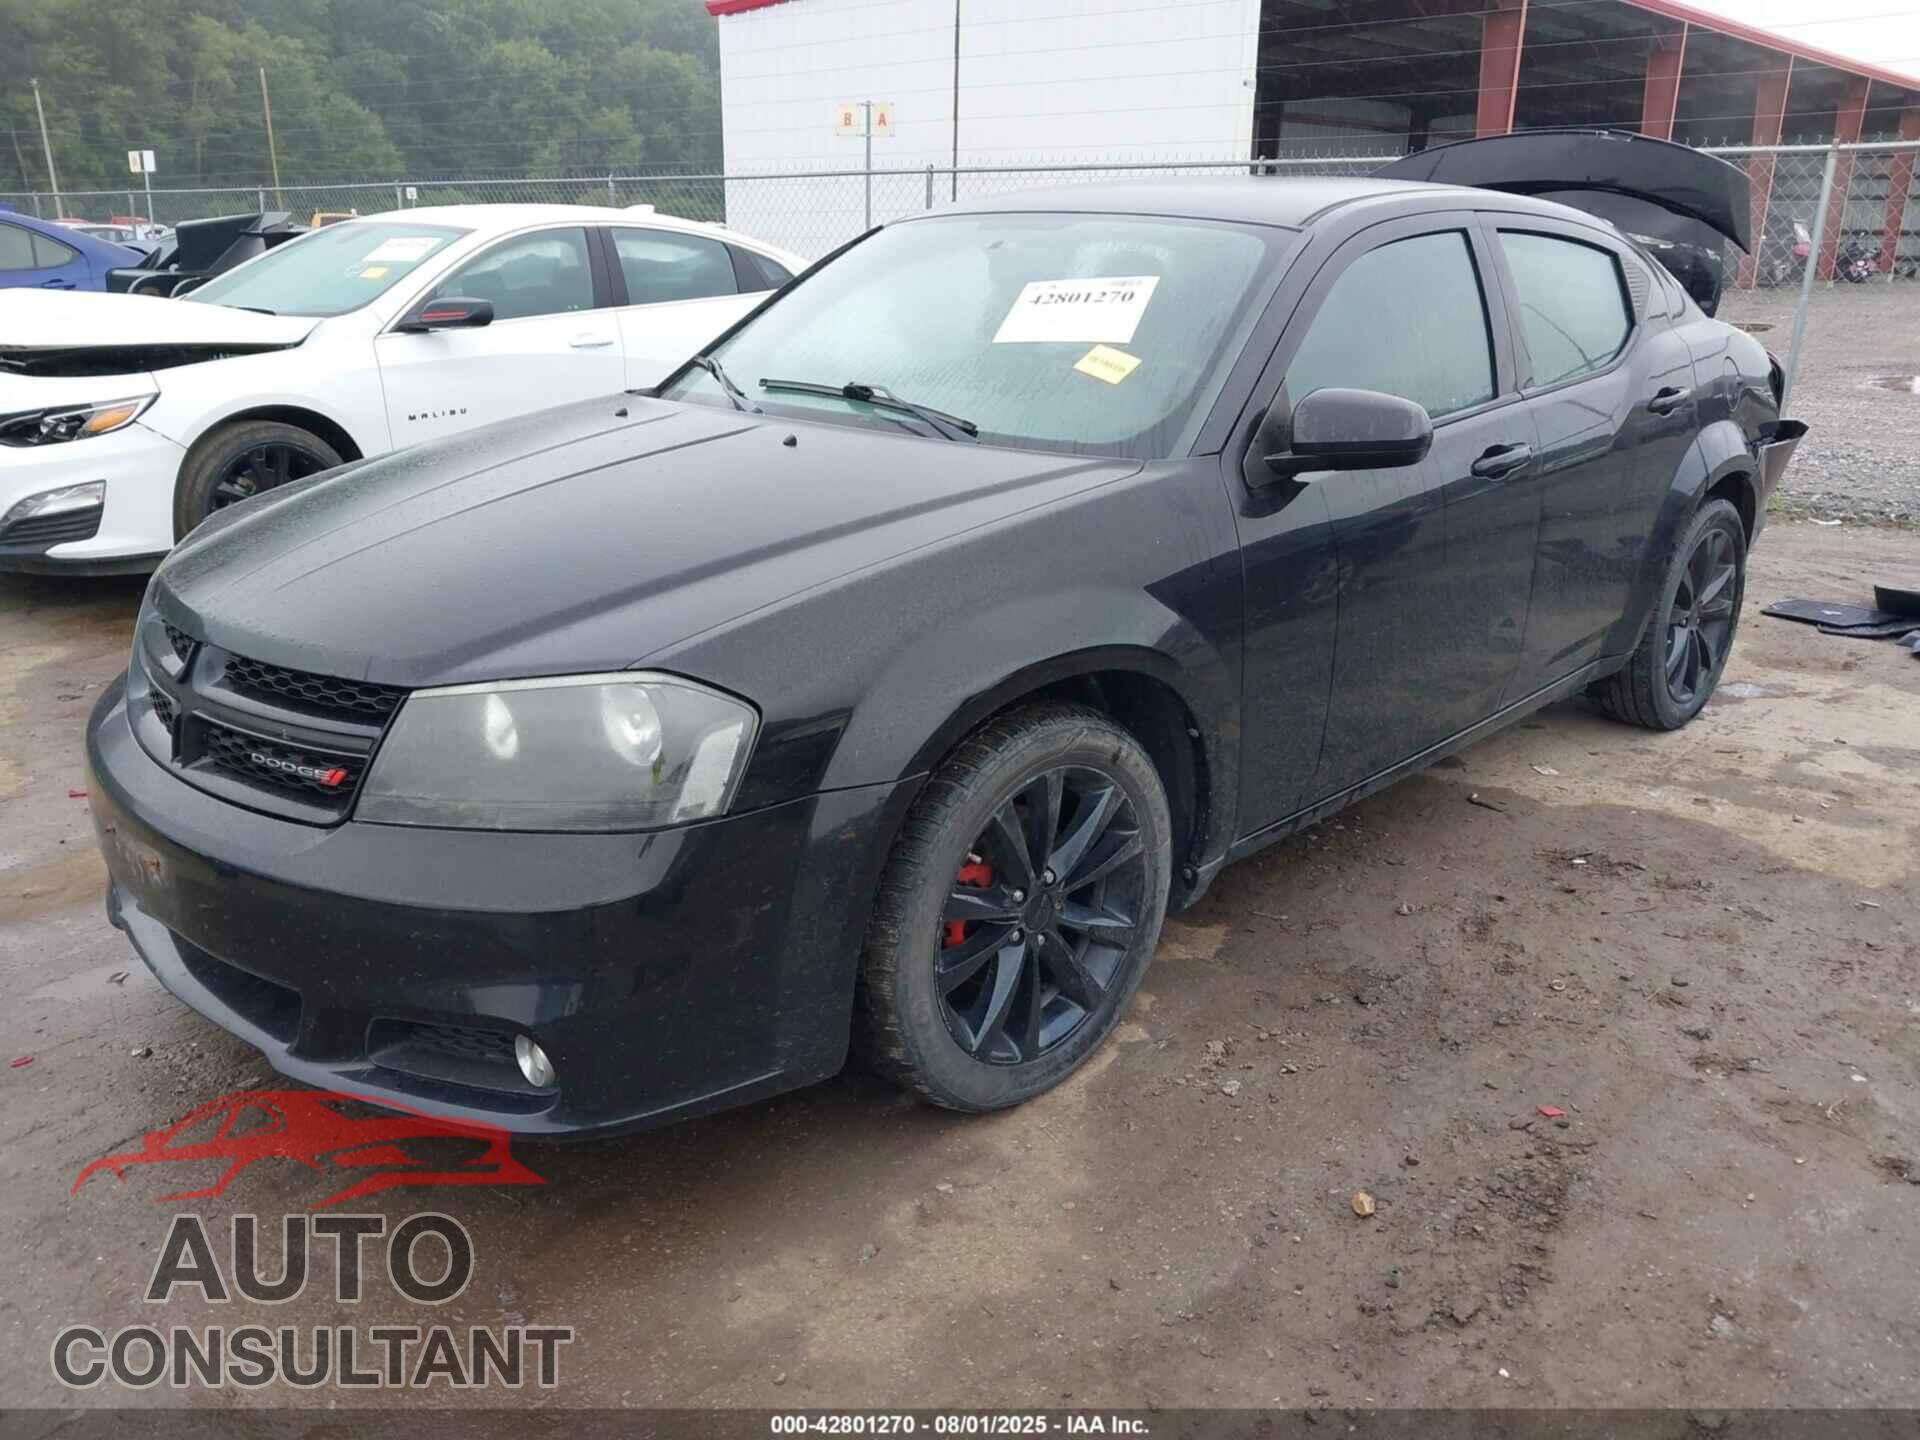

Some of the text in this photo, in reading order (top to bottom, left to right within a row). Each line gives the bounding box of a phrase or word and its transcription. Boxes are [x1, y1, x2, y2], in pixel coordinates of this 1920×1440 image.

[844, 112, 852, 126] B
[878, 112, 887, 127] A
[1029, 290, 1135, 305] 42801270
[408, 407, 467, 421] MALIBU
[251, 752, 330, 780] DODGE
